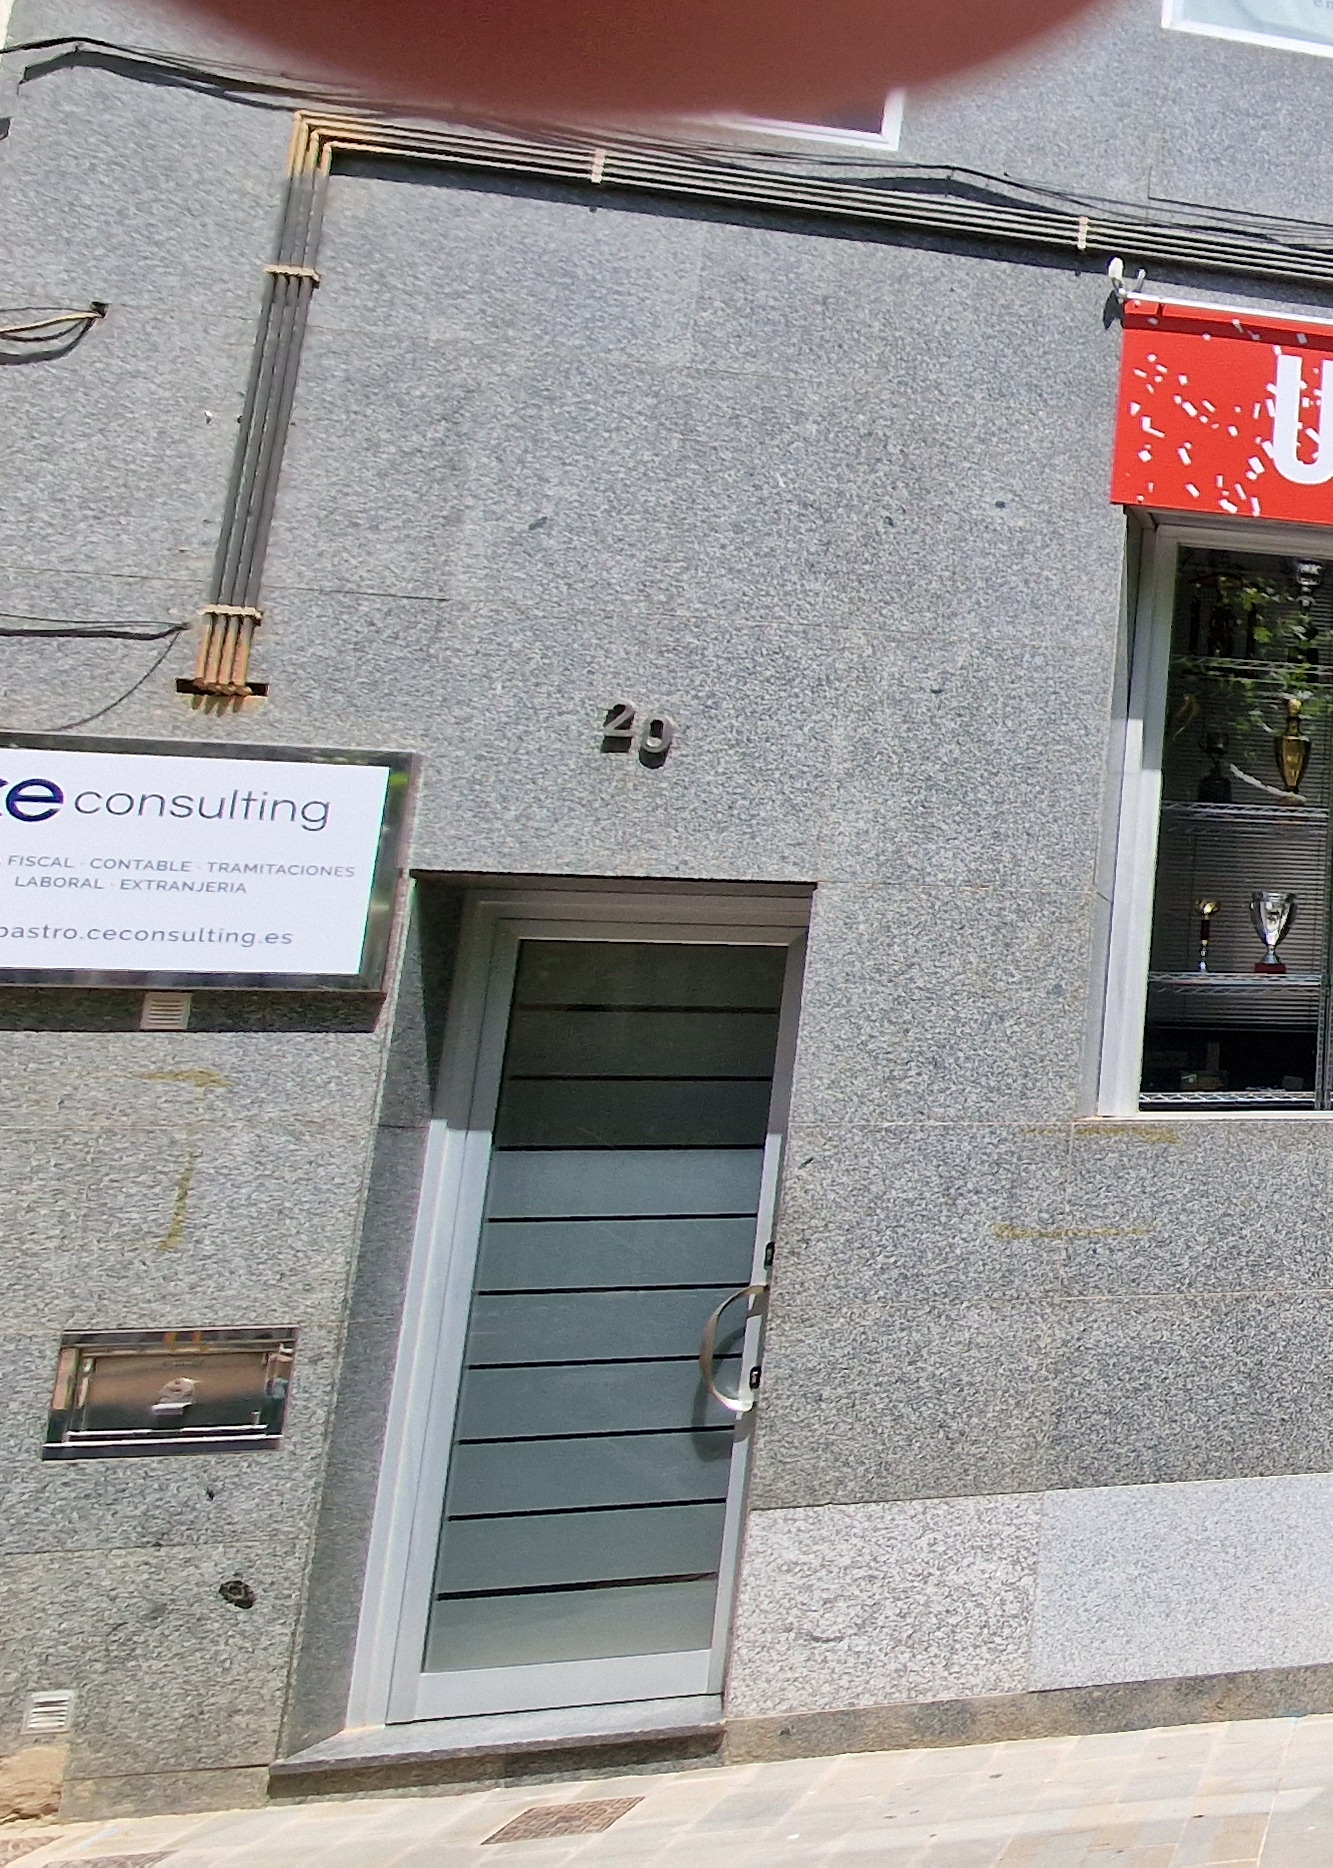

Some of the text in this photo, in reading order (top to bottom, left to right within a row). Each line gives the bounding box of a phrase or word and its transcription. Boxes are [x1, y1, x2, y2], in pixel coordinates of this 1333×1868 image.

[0, 778, 331, 832] e consulting
[7, 855, 356, 877] FISCAL CONTABLE TRAMITACIONES
[14, 875, 247, 893] LABORAL EXTRANJERIA
